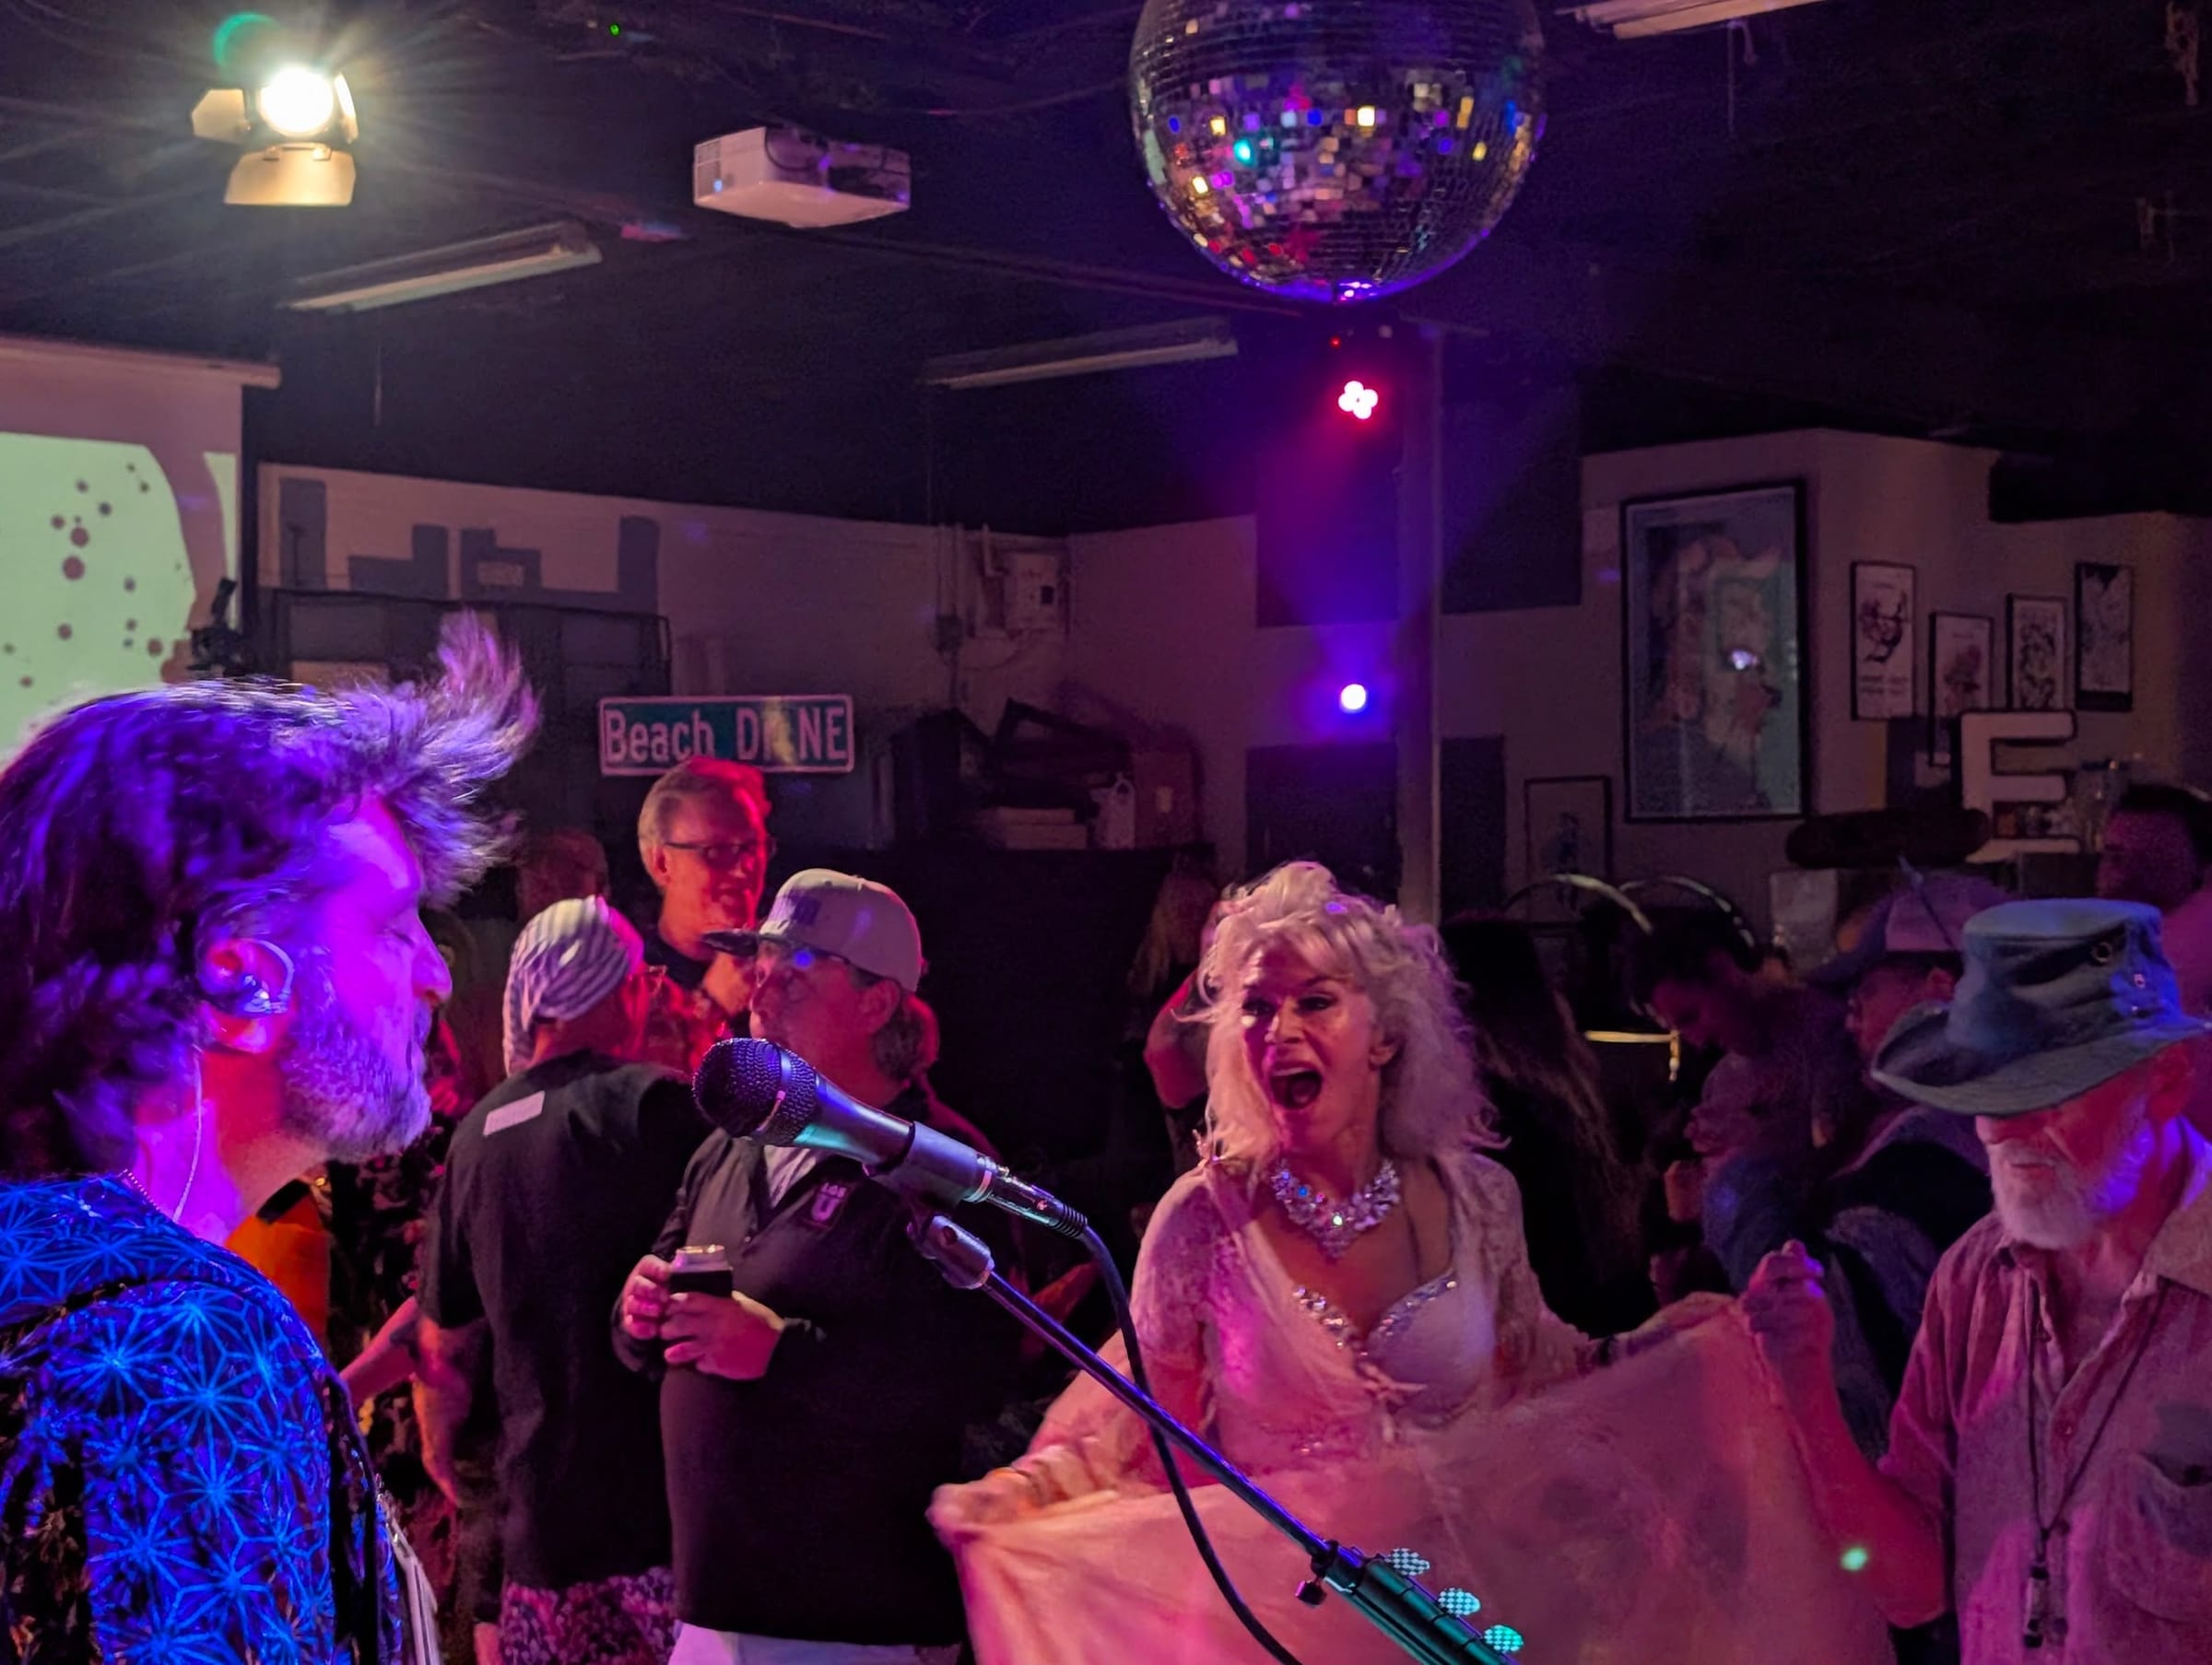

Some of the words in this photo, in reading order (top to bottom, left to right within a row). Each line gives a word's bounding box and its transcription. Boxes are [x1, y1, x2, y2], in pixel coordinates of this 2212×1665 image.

[604, 708, 716, 763] Beach
[798, 706, 846, 760] NE
[1960, 711, 2080, 863] E
